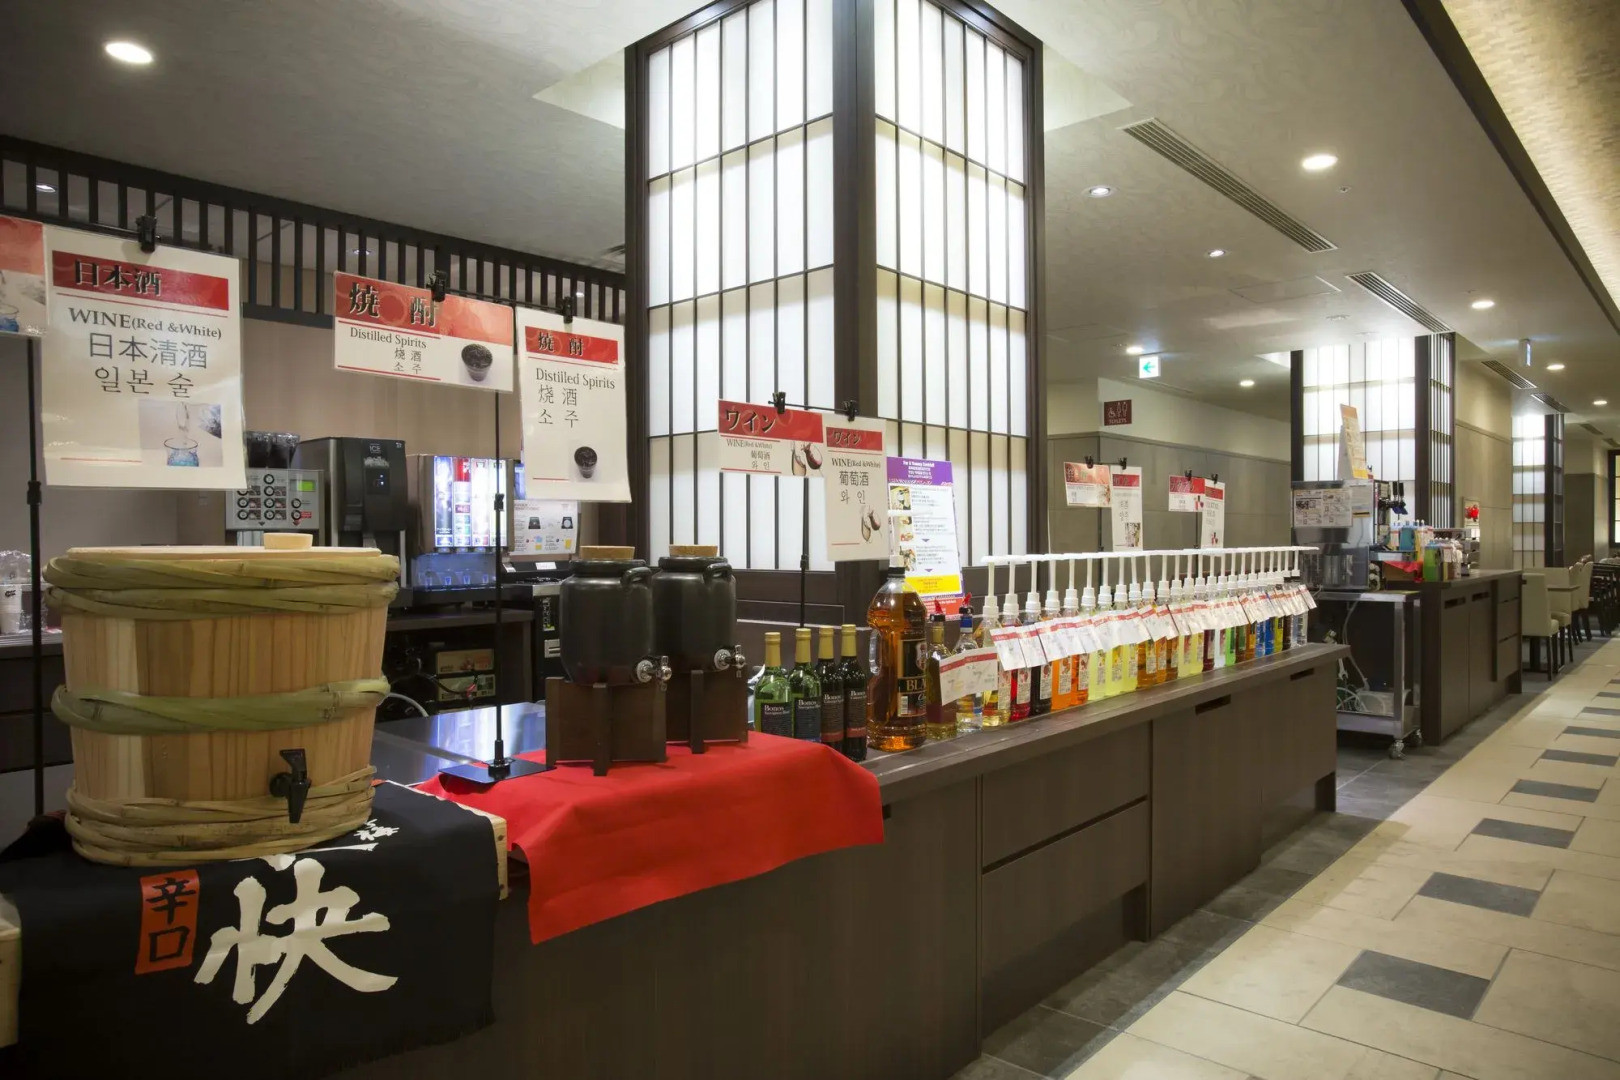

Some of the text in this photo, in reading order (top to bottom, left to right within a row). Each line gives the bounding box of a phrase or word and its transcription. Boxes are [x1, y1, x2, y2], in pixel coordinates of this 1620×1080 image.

[74, 259, 162, 297] 日本酒
[350, 327, 427, 349] Distilled Spirits
[89, 332, 208, 370] 日本清酒
[95, 366, 195, 399] 일본 술
[582, 373, 616, 390] Spirits
[725, 409, 776, 433] ワイン
[832, 431, 861, 446] ワイン
[839, 471, 869, 486] 葡萄酒
[147, 876, 198, 963] 辛口
